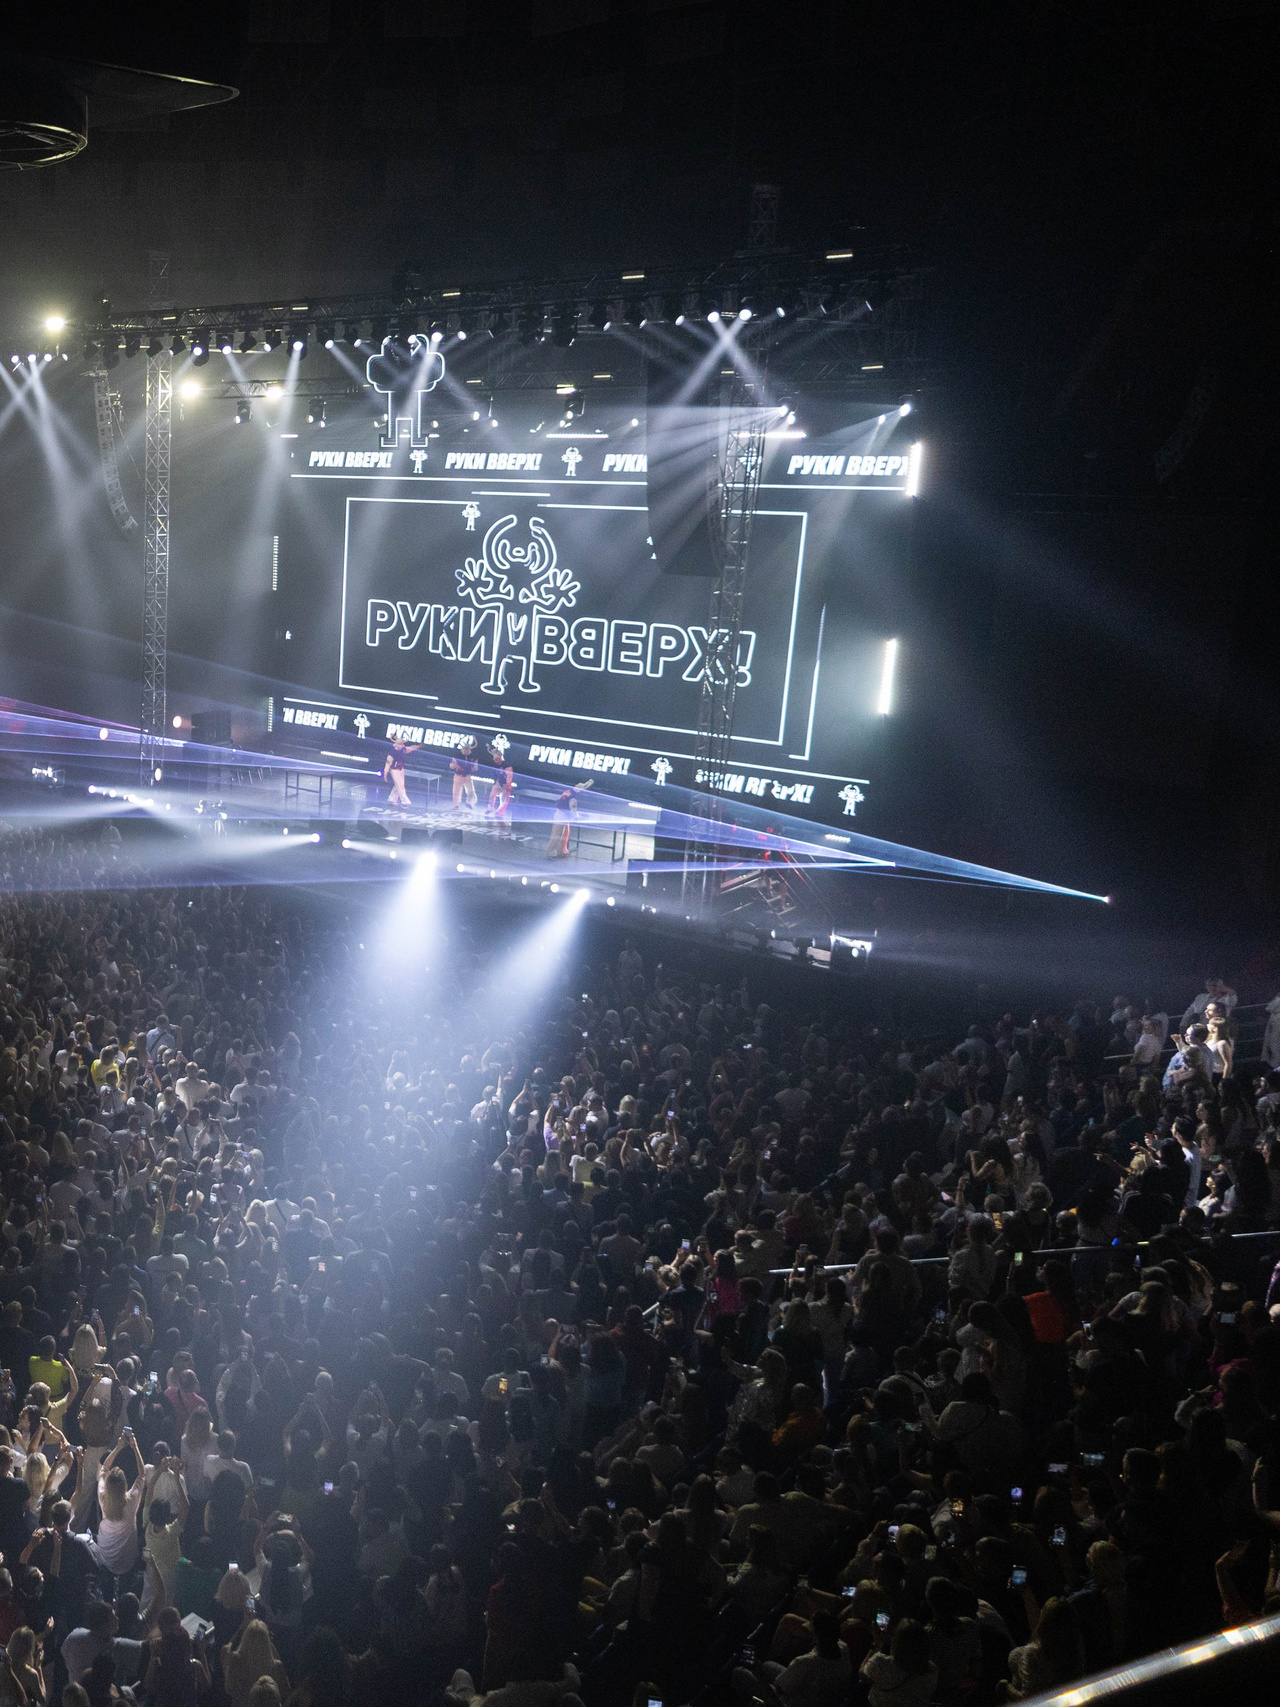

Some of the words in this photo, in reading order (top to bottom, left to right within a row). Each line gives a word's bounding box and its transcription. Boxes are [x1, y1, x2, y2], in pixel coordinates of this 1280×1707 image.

[308, 451, 345, 467] РУКИ
[345, 451, 394, 468] ВВЕРХ!
[444, 452, 487, 470] РУКИ
[486, 453, 543, 471] ВВЕРХ!
[602, 454, 648, 472] РУКИ
[787, 455, 846, 475] РУКИ
[366, 599, 500, 665] РУКИ
[294, 709, 340, 731] ВВЕРХ!
[528, 744, 573, 767] РУКИ
[572, 751, 632, 775] ВВЕРХ!
